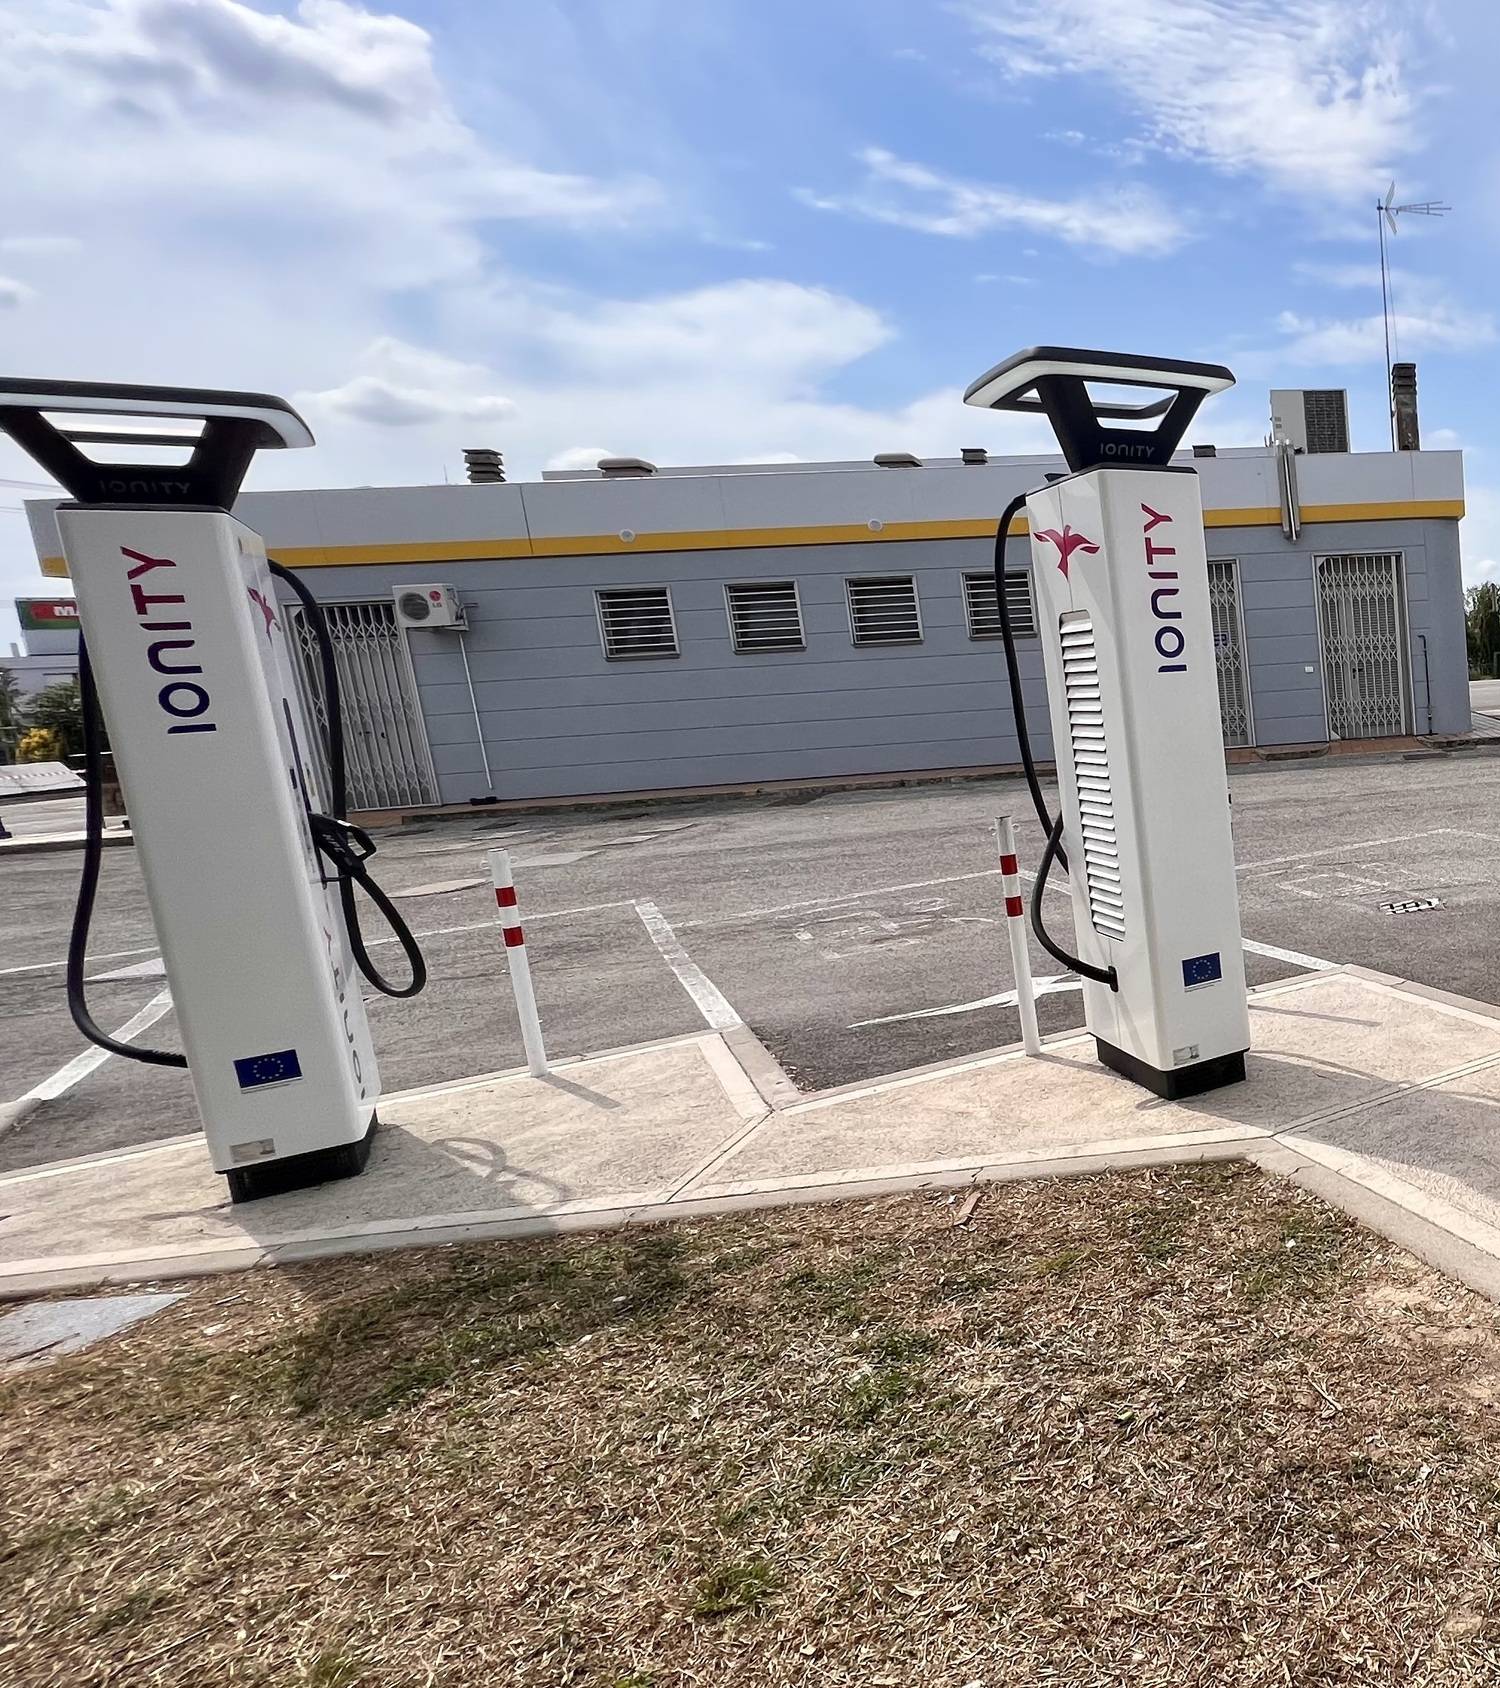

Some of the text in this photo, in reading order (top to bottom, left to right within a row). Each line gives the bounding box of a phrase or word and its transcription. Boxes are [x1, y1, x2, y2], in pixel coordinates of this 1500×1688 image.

[98, 479, 191, 495] IONITY
[1099, 442, 1156, 458] IONITY
[1140, 502, 1188, 673] IONITY
[119, 545, 218, 735] IONITY
